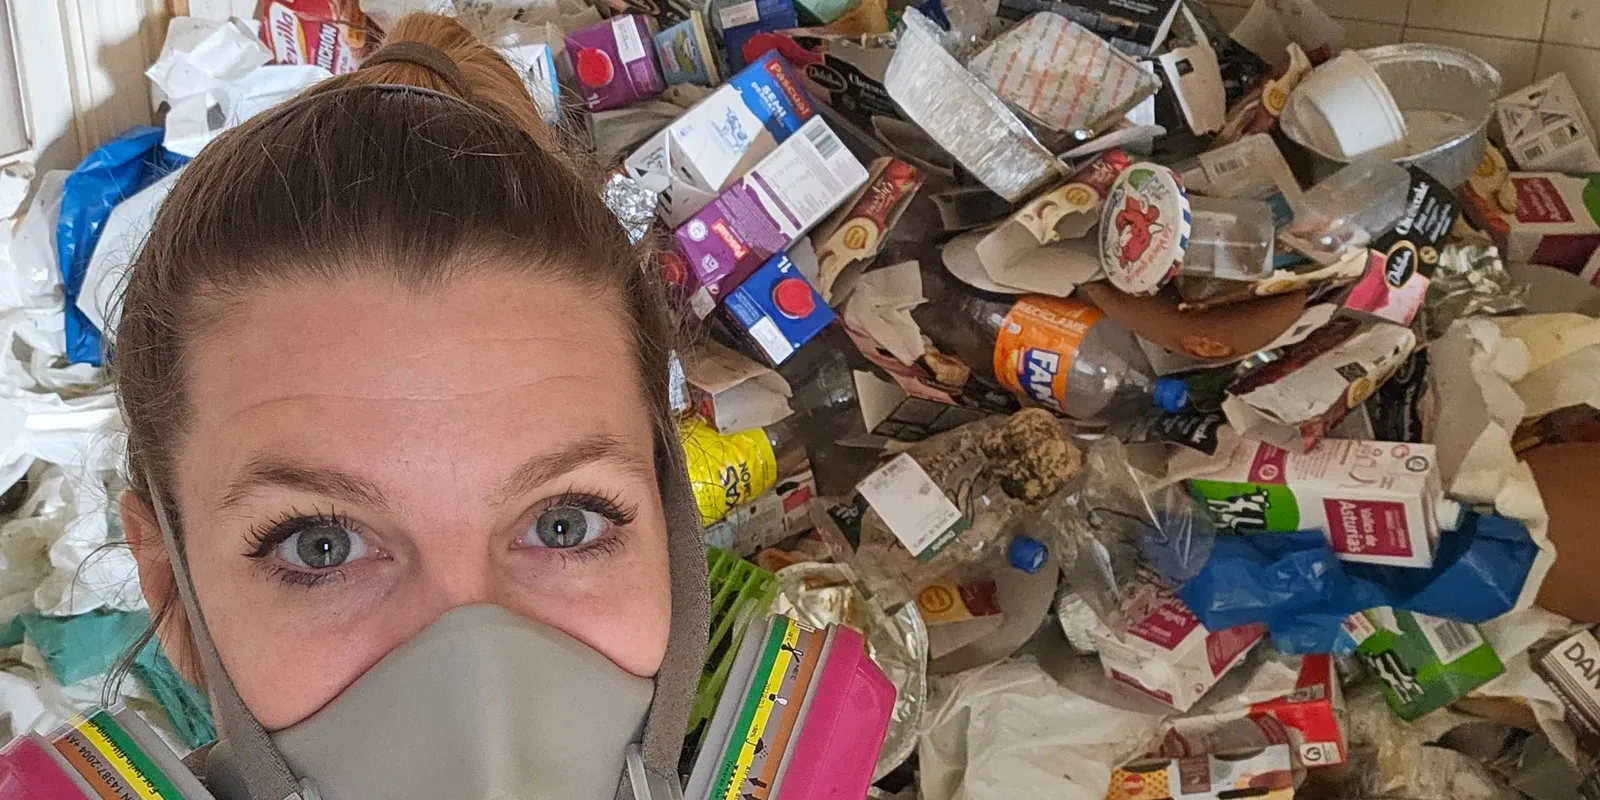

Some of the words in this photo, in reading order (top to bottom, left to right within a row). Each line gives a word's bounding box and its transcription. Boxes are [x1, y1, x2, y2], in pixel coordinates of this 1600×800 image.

[317, 23, 338, 72] HICHÓN
[761, 83, 787, 118] SEMI
[769, 62, 811, 116] Pascual
[714, 221, 748, 259] Pascual
[776, 255, 793, 274] 1L
[738, 460, 752, 504] MON
[1338, 500, 1362, 553] Asturias
[95, 725, 126, 760] filtering
[78, 745, 124, 794] 14387:2004
[125, 757, 145, 779] twin
[142, 774, 160, 796] For
